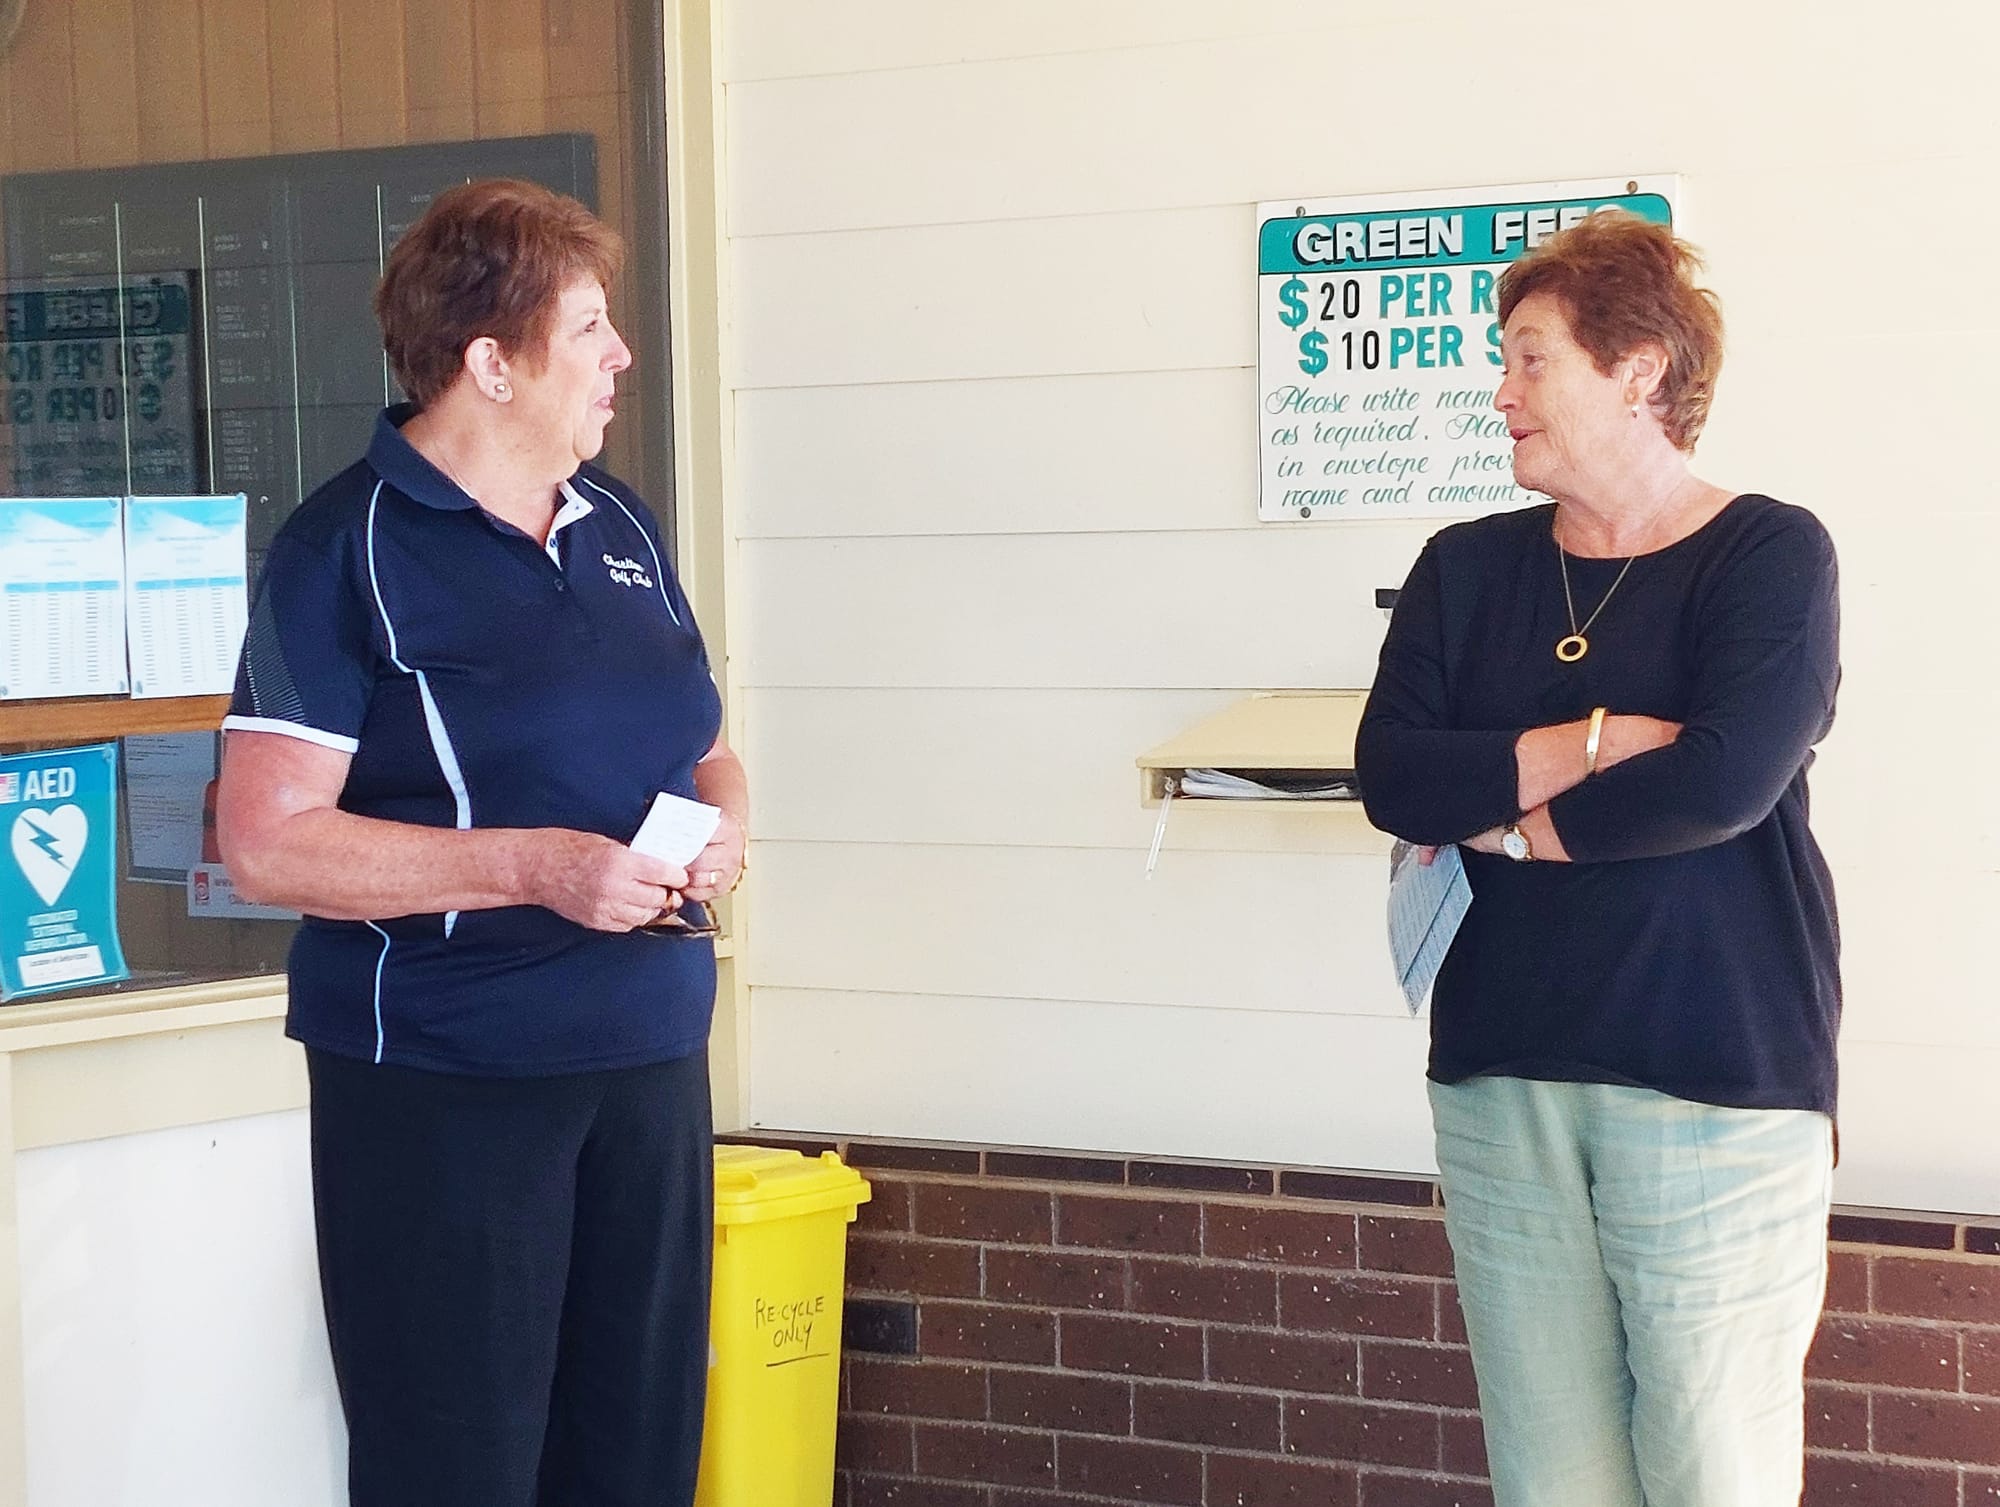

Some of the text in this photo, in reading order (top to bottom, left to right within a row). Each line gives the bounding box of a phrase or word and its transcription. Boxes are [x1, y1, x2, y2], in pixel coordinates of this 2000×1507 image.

[1293, 204, 1626, 265] GREEN FEE
[1379, 272, 1453, 319] PER
[1390, 325, 1464, 370] PER
[1265, 385, 1494, 415] Please write nam
[1271, 425, 1299, 446] as
[1277, 450, 1514, 482] in envelope prov
[1282, 488, 1349, 507] name
[1362, 480, 1414, 505] and
[632, 571, 654, 589] Club
[23, 766, 76, 801] AED
[773, 1321, 813, 1352] ONLY
